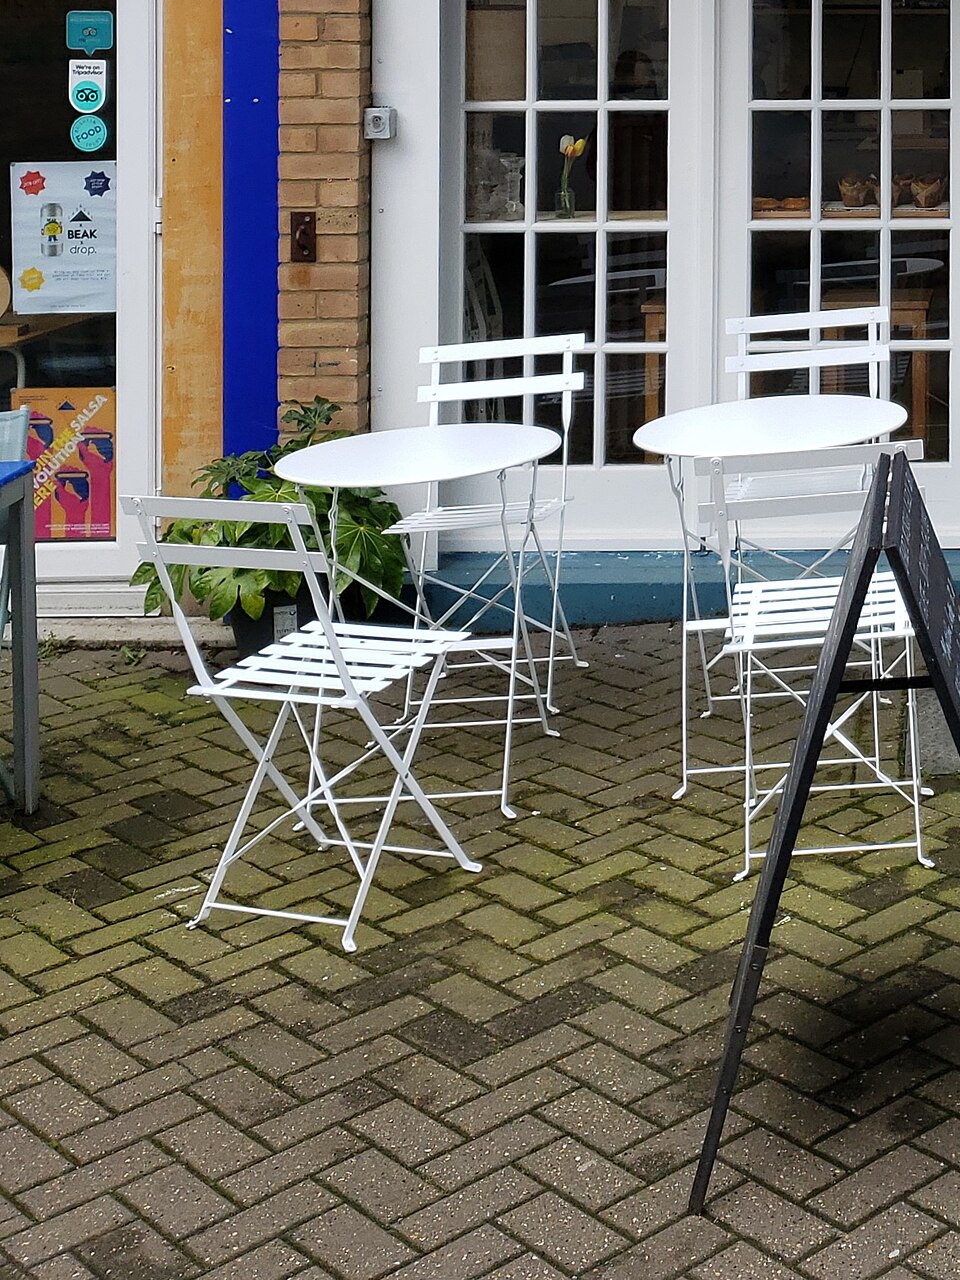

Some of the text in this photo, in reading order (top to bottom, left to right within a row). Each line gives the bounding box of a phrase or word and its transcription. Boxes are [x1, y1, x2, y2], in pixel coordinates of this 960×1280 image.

[76, 125, 102, 142] FOOD
[67, 229, 97, 239] BEAK
[49, 428, 75, 452] THE
[70, 394, 108, 431] SALSA
[33, 432, 86, 489] VOLUTION
[34, 479, 57, 508] ERE
